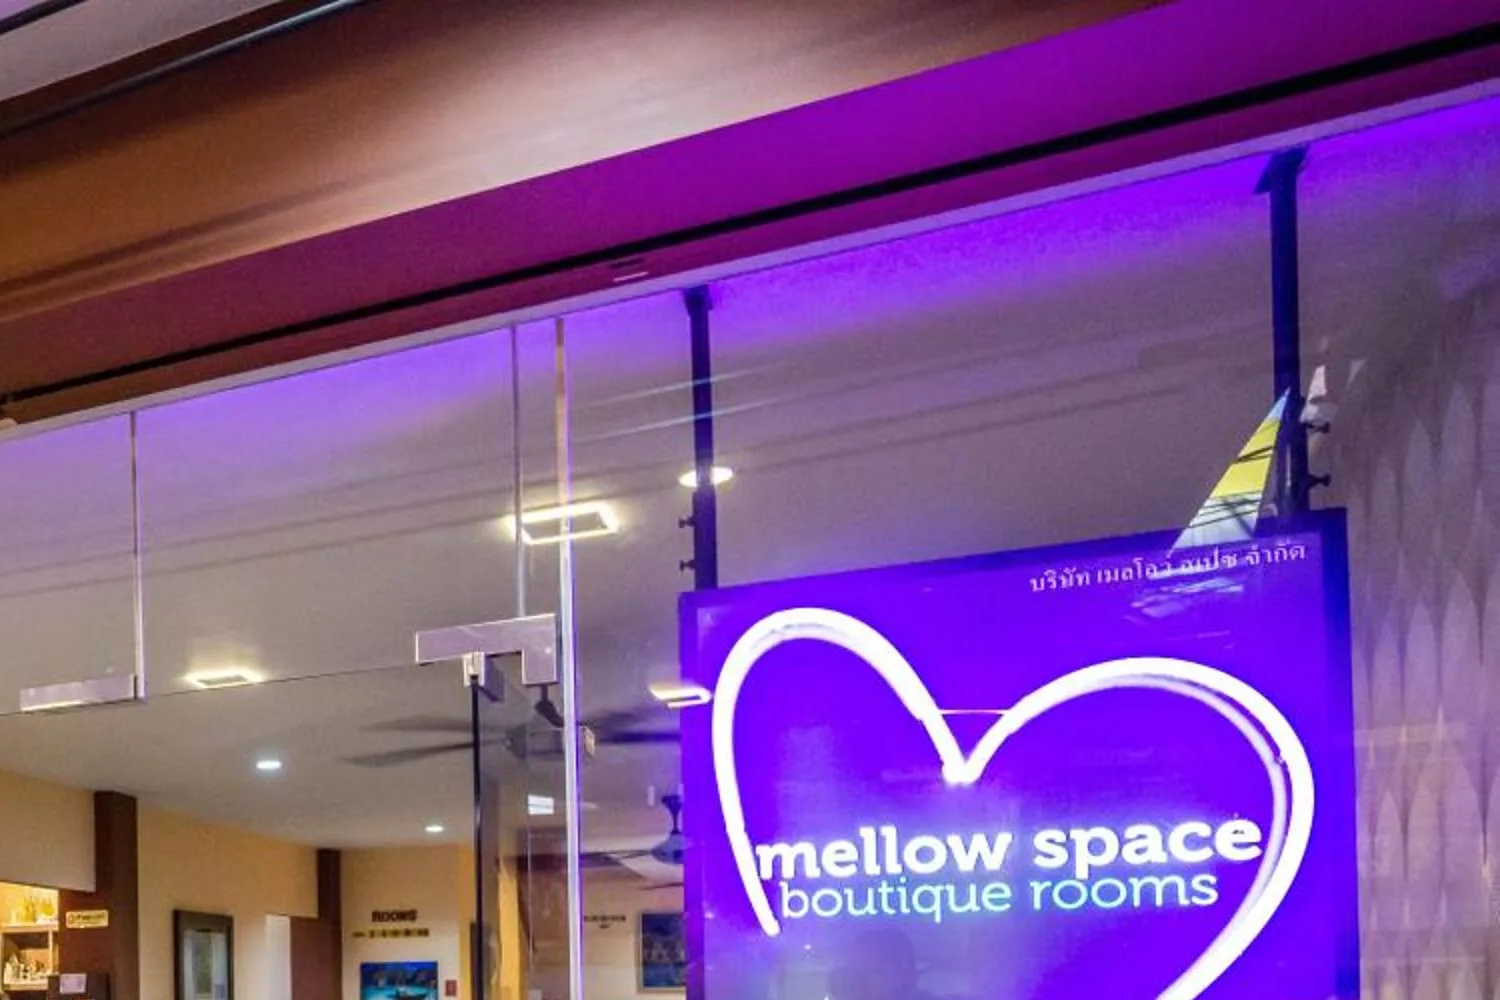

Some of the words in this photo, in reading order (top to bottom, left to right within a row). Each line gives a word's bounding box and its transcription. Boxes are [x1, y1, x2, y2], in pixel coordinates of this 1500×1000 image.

[758, 825, 1013, 881] mellow
[1032, 817, 1264, 880] space
[780, 876, 1012, 923] boutique
[1031, 871, 1219, 911] rooms
